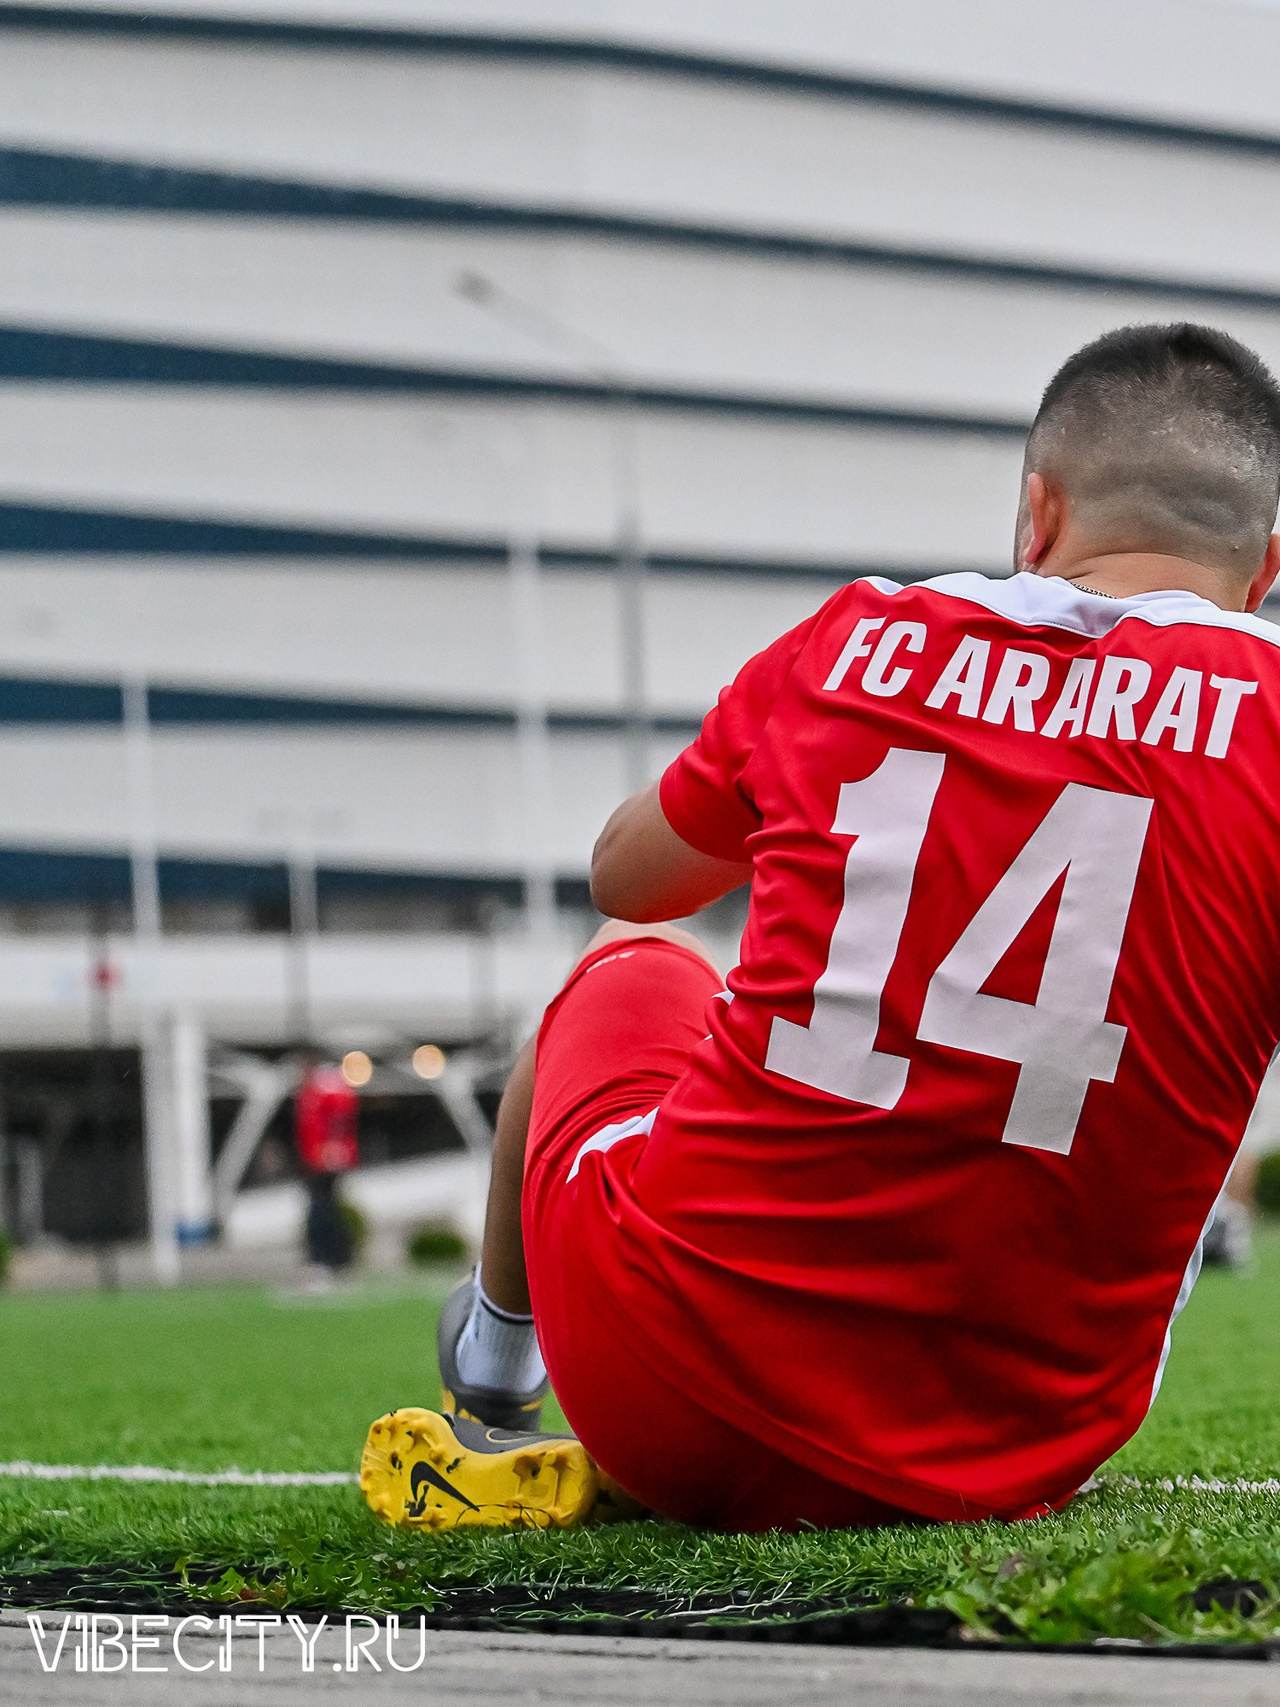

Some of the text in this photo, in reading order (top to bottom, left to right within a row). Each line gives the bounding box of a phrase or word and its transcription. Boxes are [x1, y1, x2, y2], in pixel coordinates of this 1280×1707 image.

[822, 617, 1258, 759] FC ARARAT
[764, 746, 1154, 1155] 14
